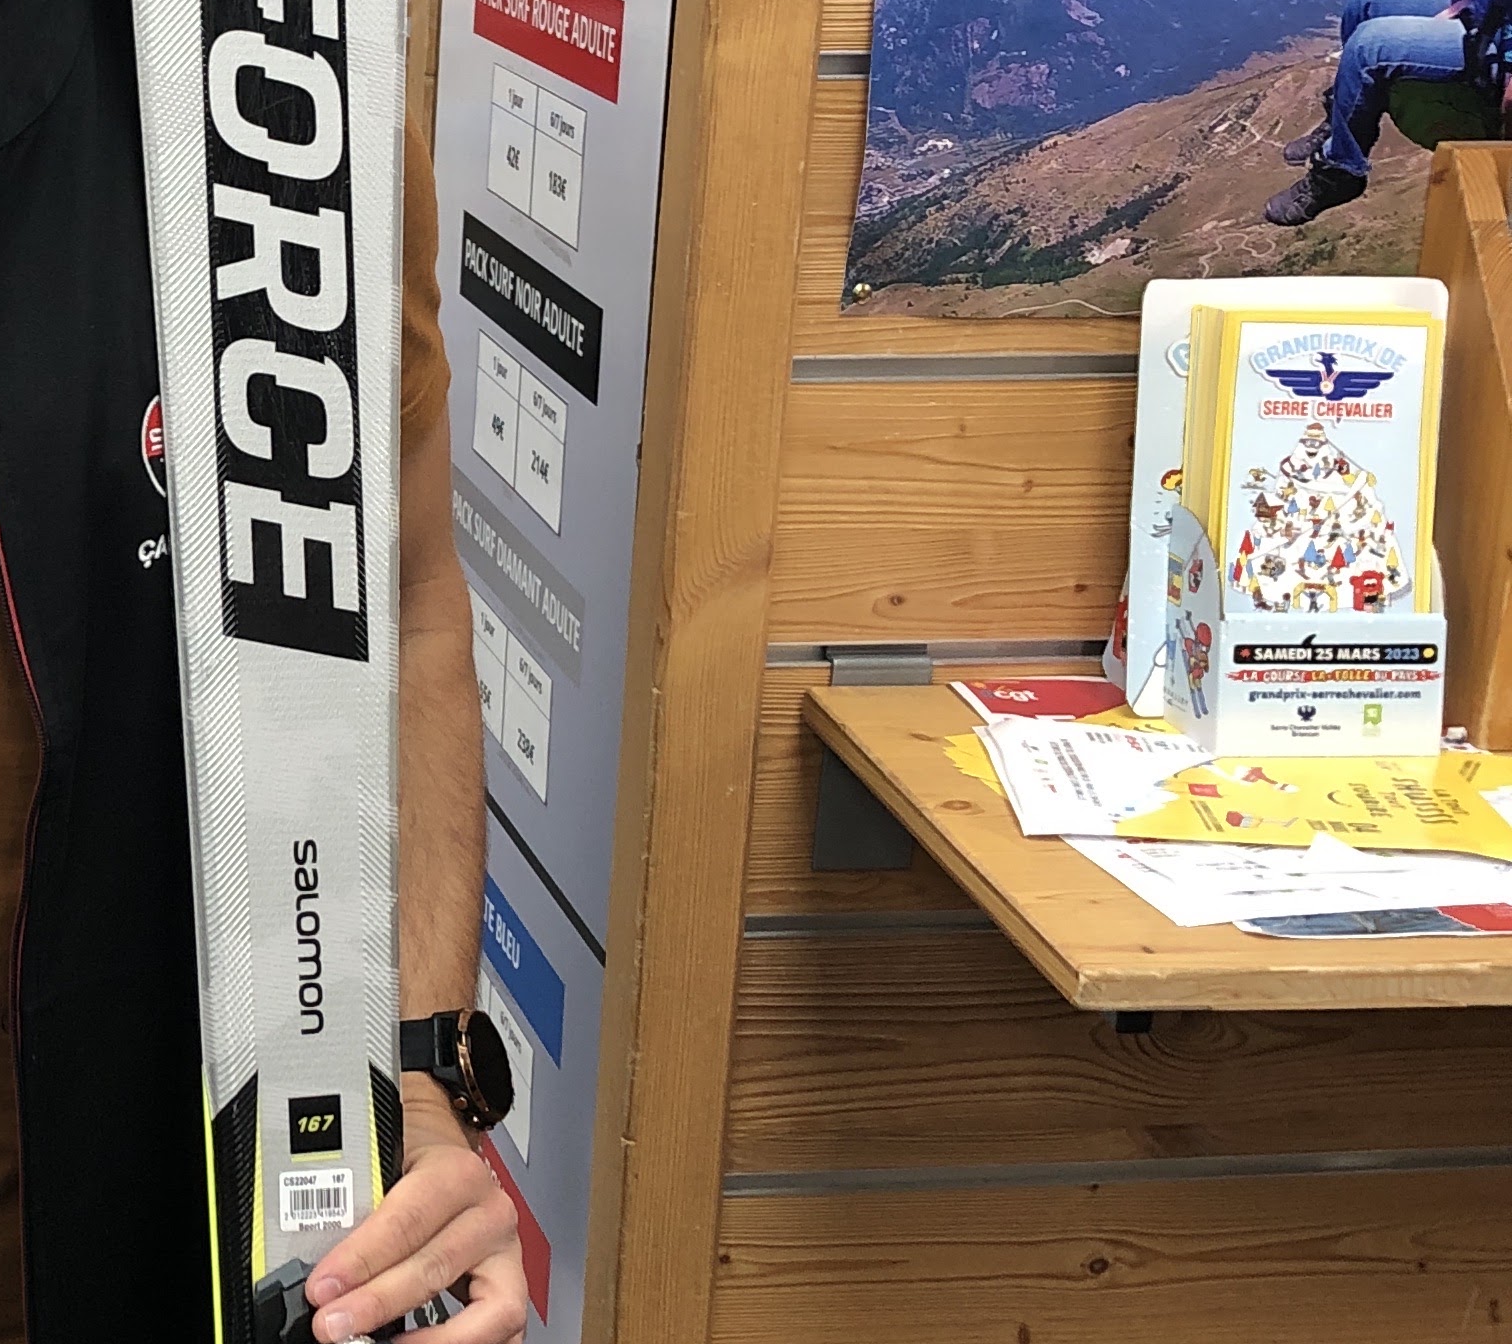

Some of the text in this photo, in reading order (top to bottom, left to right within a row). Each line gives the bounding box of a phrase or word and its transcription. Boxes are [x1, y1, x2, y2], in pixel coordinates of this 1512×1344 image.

[570, 12, 617, 64] ADULTE
[464, 238, 586, 357] PACK SURF NOIR ADULTE
[1253, 332, 1407, 373] GRAND PRIX DE
[1263, 400, 1393, 419] SERRE CHEVALIER
[452, 489, 581, 653] PACK SURF DIAMANT ADULTE
[1254, 647, 1420, 661] SAMEDI 25 MARS 2023
[1242, 671, 1259, 682] LA
[1262, 671, 1307, 683] COURSE
[993, 687, 1039, 703] cgt
[1248, 688, 1422, 703] grandprix-serrechevalier.com
[293, 839, 324, 1036] salomon
[495, 912, 521, 970] BLEU
[297, 1114, 335, 1133] 167
[283, 1175, 317, 1187] CS22047
